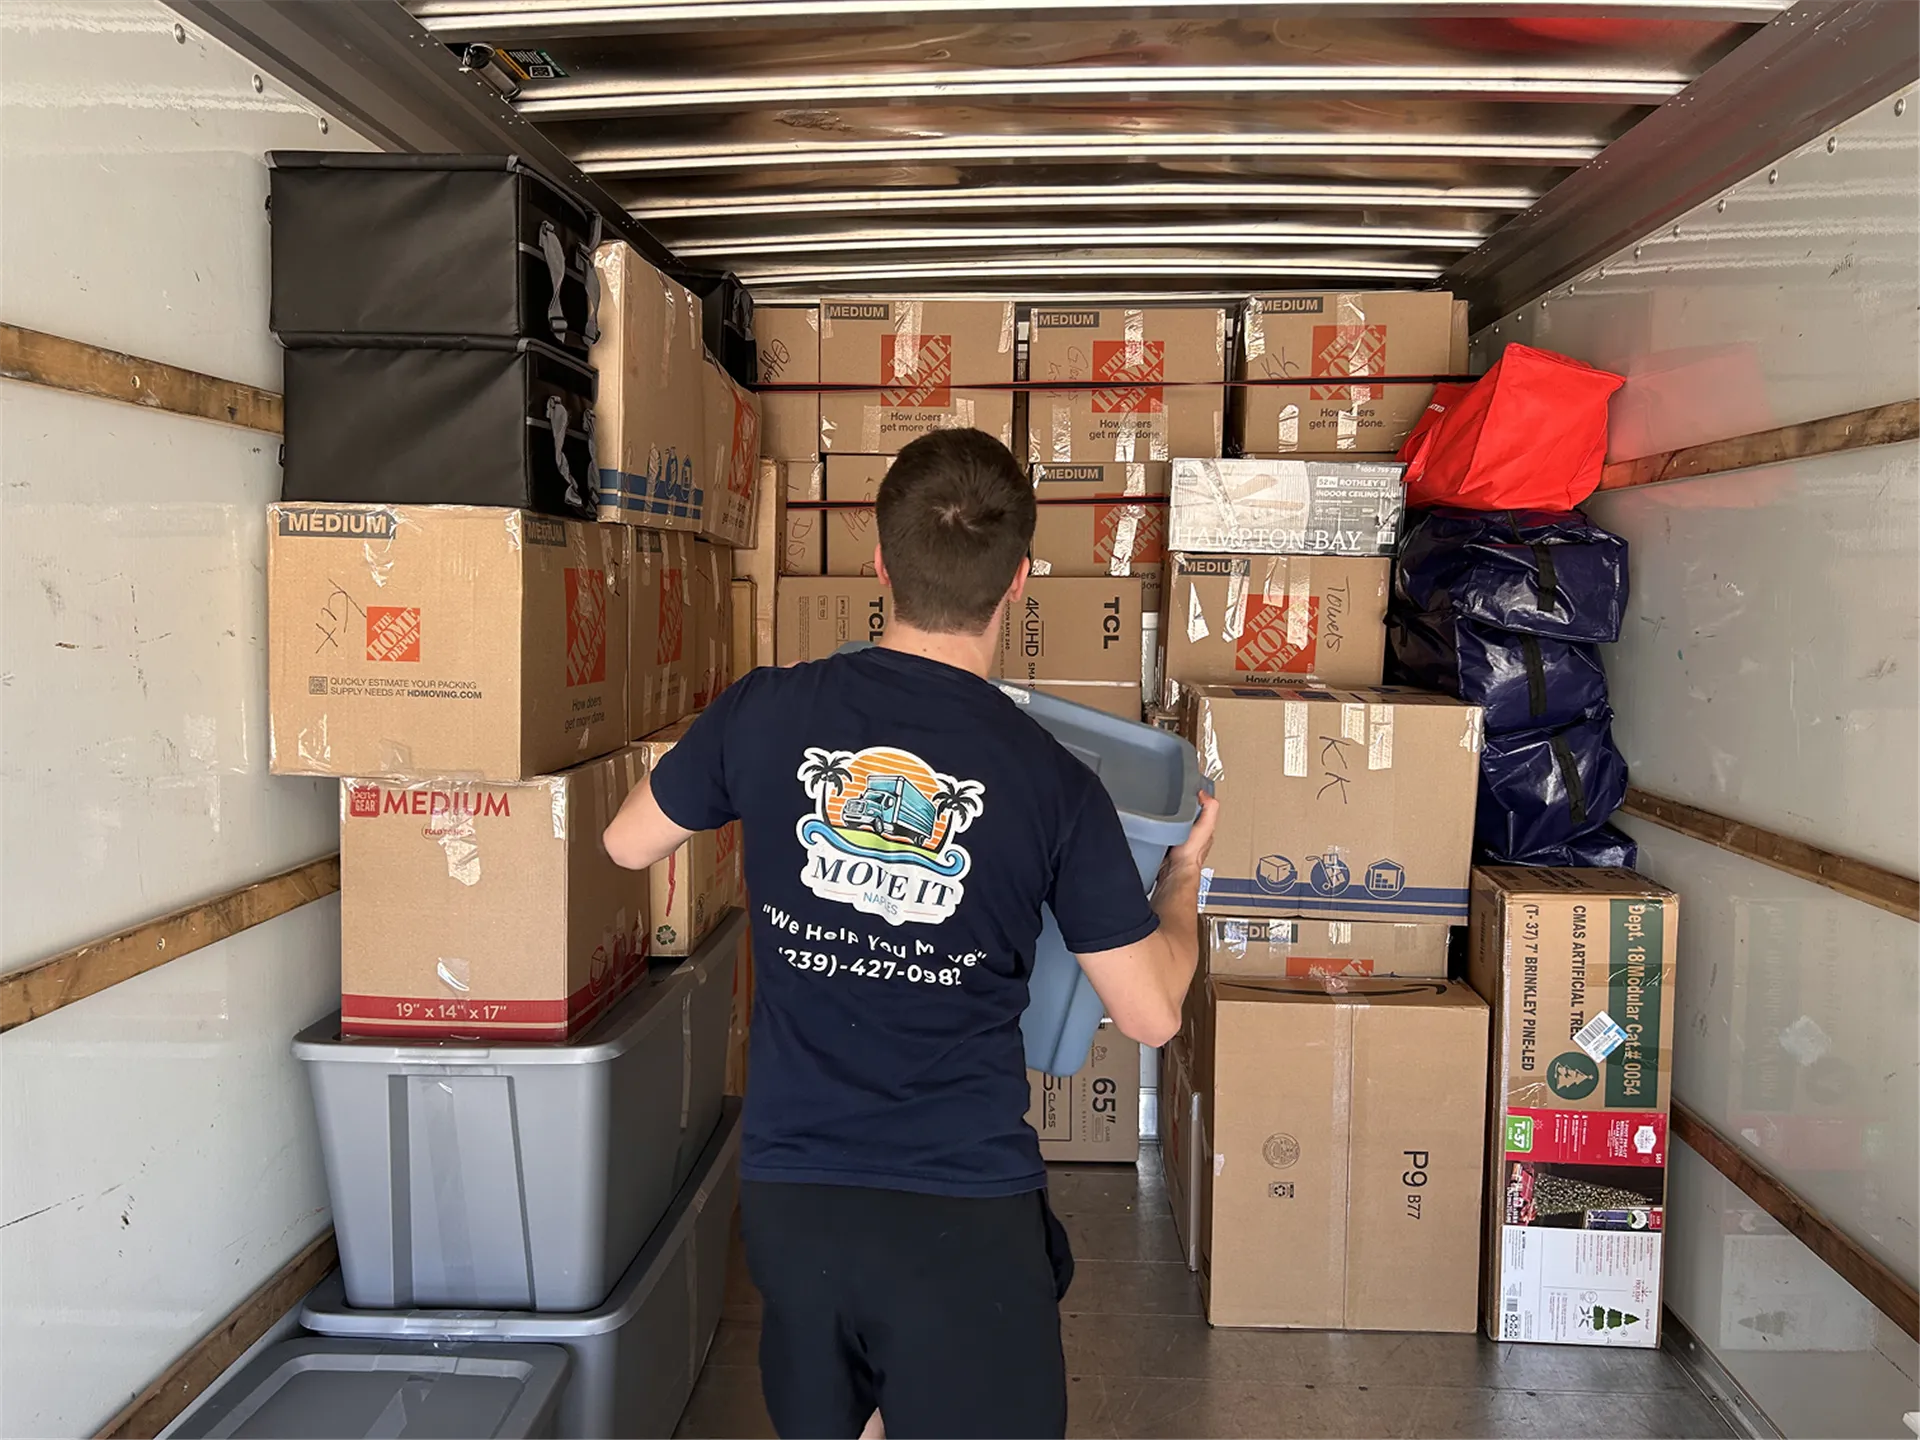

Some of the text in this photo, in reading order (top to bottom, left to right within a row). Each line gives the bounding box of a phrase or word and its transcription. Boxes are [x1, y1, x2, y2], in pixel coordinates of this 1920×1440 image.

[830, 307, 884, 318] MEDIUM
[1039, 314, 1094, 325] MEDIUM
[1262, 300, 1318, 311] MEDIUM
[1099, 348, 1126, 377] THE
[907, 362, 951, 407] DEPOT
[880, 423, 896, 433] get
[898, 424, 924, 432] more
[891, 412, 941, 422] How doers
[1309, 420, 1325, 430] get
[1089, 431, 1106, 441] get
[1045, 469, 1099, 480] MEDIUM
[287, 513, 388, 534] MEDIUM
[1174, 526, 1364, 551] HAMPTON BAY
[1183, 560, 1247, 574] MEDIUM
[371, 612, 394, 633] THE
[868, 596, 884, 643] TCL
[1025, 596, 1040, 658] 4KUHD
[1102, 596, 1121, 650] TCL
[1323, 576, 1351, 653] Towels
[366, 607, 421, 661] HOME
[387, 627, 421, 661] DEPOT
[330, 677, 477, 689] QUICKLY ESTIMATE YOUR PACKING
[330, 687, 482, 699] SUPPLY NEEDS AT HDMOVING.COM
[564, 718, 577, 734] get
[1314, 735, 1350, 805] KK
[355, 800, 376, 812] GEAR
[383, 790, 511, 817] MEDIUM
[812, 856, 955, 908] MOVE IT
[1572, 905, 1586, 939] CMAS
[1624, 904, 1646, 941] Dept.
[868, 935, 906, 959] You
[915, 939, 988, 968] Mve"
[1525, 943, 1538, 954] 7'
[778, 946, 963, 987] 239)-427-0982
[1571, 942, 1586, 1007] ARTIFICIAL
[1523, 956, 1538, 1015] BRINKLEY
[396, 1003, 507, 1019] 19" x 14" x 17"
[1521, 1019, 1537, 1071] PINE-LED
[1624, 1023, 1644, 1059] Cat.#
[1623, 1063, 1642, 1096] 0054
[1047, 1091, 1056, 1129] CLASS
[1092, 1077, 1117, 1125] 65"
[1513, 1121, 1527, 1149] T-37
[1402, 1151, 1429, 1220] P9 B77
